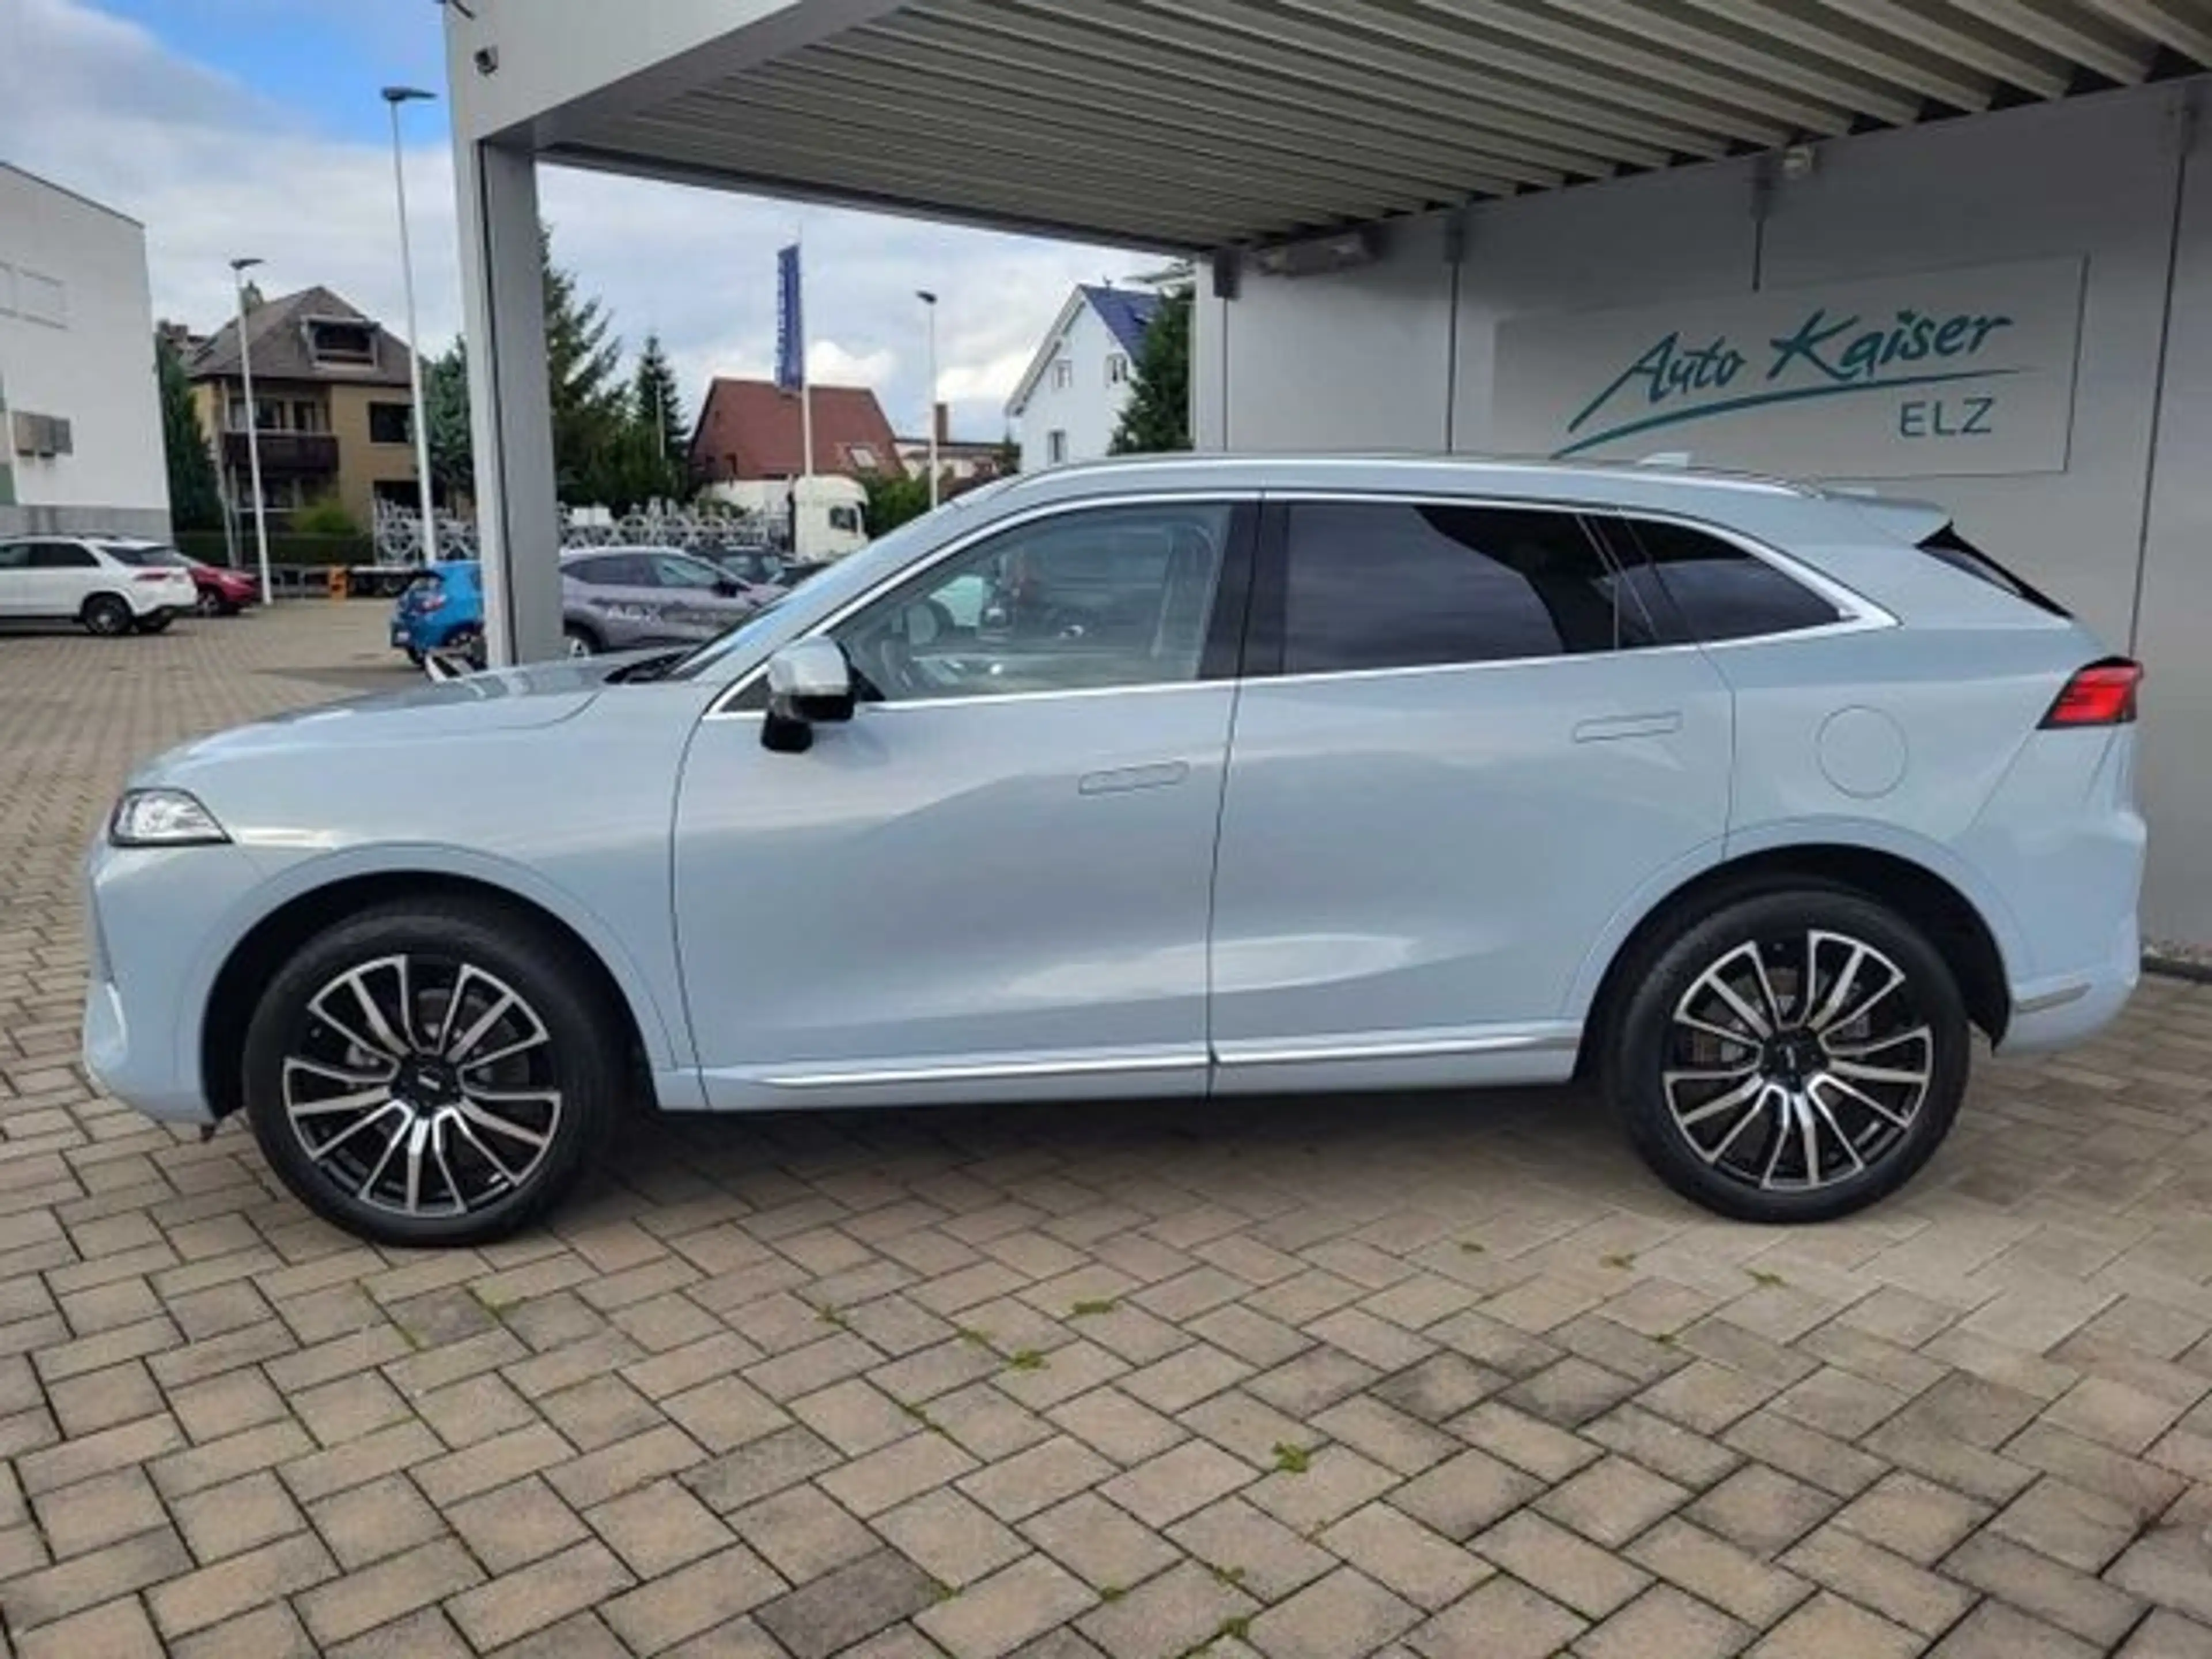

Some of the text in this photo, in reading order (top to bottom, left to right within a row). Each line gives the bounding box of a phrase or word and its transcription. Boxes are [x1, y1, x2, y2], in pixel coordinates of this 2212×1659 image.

[1567, 308, 2013, 432] Auto Kaiser
[1900, 397, 1994, 437] ELZ
